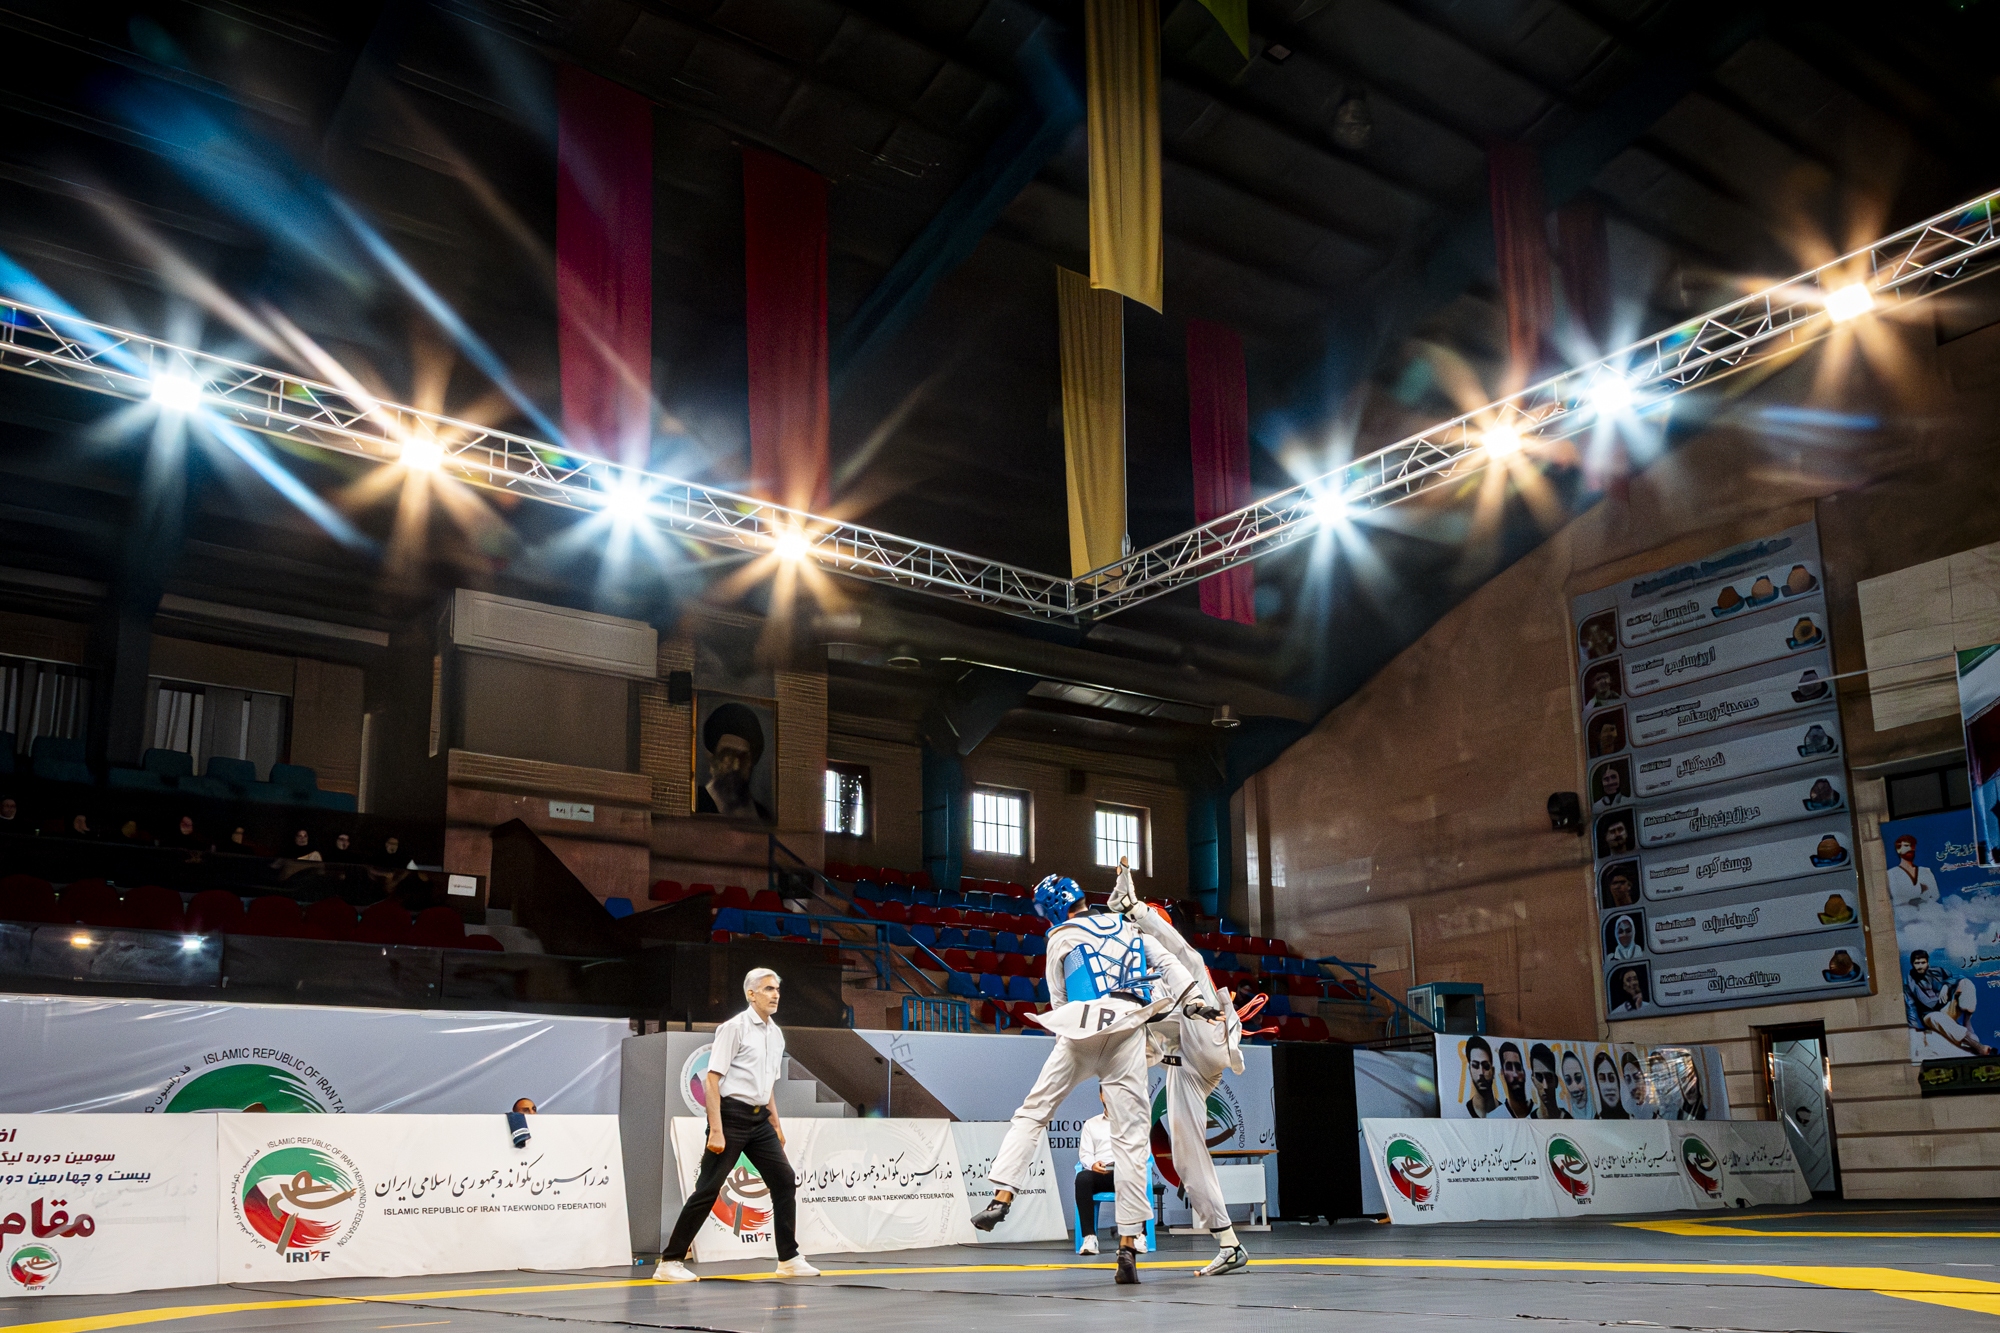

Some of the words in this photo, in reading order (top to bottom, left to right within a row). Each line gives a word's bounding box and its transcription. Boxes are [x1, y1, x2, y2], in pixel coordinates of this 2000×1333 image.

[203, 1047, 250, 1066] ISLAMIC
[252, 1047, 304, 1072] REPUBLIC
[303, 1065, 321, 1079] OF
[315, 1076, 339, 1100] IRAN
[267, 1137, 296, 1149] ISLAMIC
[297, 1136, 332, 1151] REPUBLIC
[26, 1153, 61, 1164] دوره
[65, 1151, 116, 1166] سومین
[331, 1147, 342, 1156] OF
[339, 1153, 355, 1169] IRAN
[0, 1174, 23, 1185] دور
[28, 1171, 91, 1187] چهارمین
[95, 1173, 104, 1184] و
[108, 1170, 152, 1184] بیست
[530, 1164, 610, 1196] فدراسیون
[817, 1167, 845, 1190] اسلامی
[899, 1161, 953, 1188] فدراسیون
[351, 1166, 367, 1209] TAEKWONDO
[374, 1174, 412, 1201] ایران
[411, 1172, 452, 1199] اسلامی
[802, 1196, 827, 1204] ISLAMIC
[827, 1195, 857, 1203] REPUBLIC
[858, 1194, 867, 1202] OF
[868, 1194, 882, 1202] IRAN
[882, 1193, 919, 1201] TAEKWONDO
[919, 1192, 955, 1200] FEDERATION
[383, 1207, 420, 1216] ISLAMIC
[421, 1206, 465, 1215] REPUBLIC
[466, 1205, 479, 1214] OF
[480, 1205, 501, 1213] IRAN
[502, 1202, 556, 1212] TAEKWONDO
[556, 1201, 607, 1211] FEDERATION
[0, 1197, 96, 1254] مقام
[337, 1208, 365, 1248] FEDERATION
